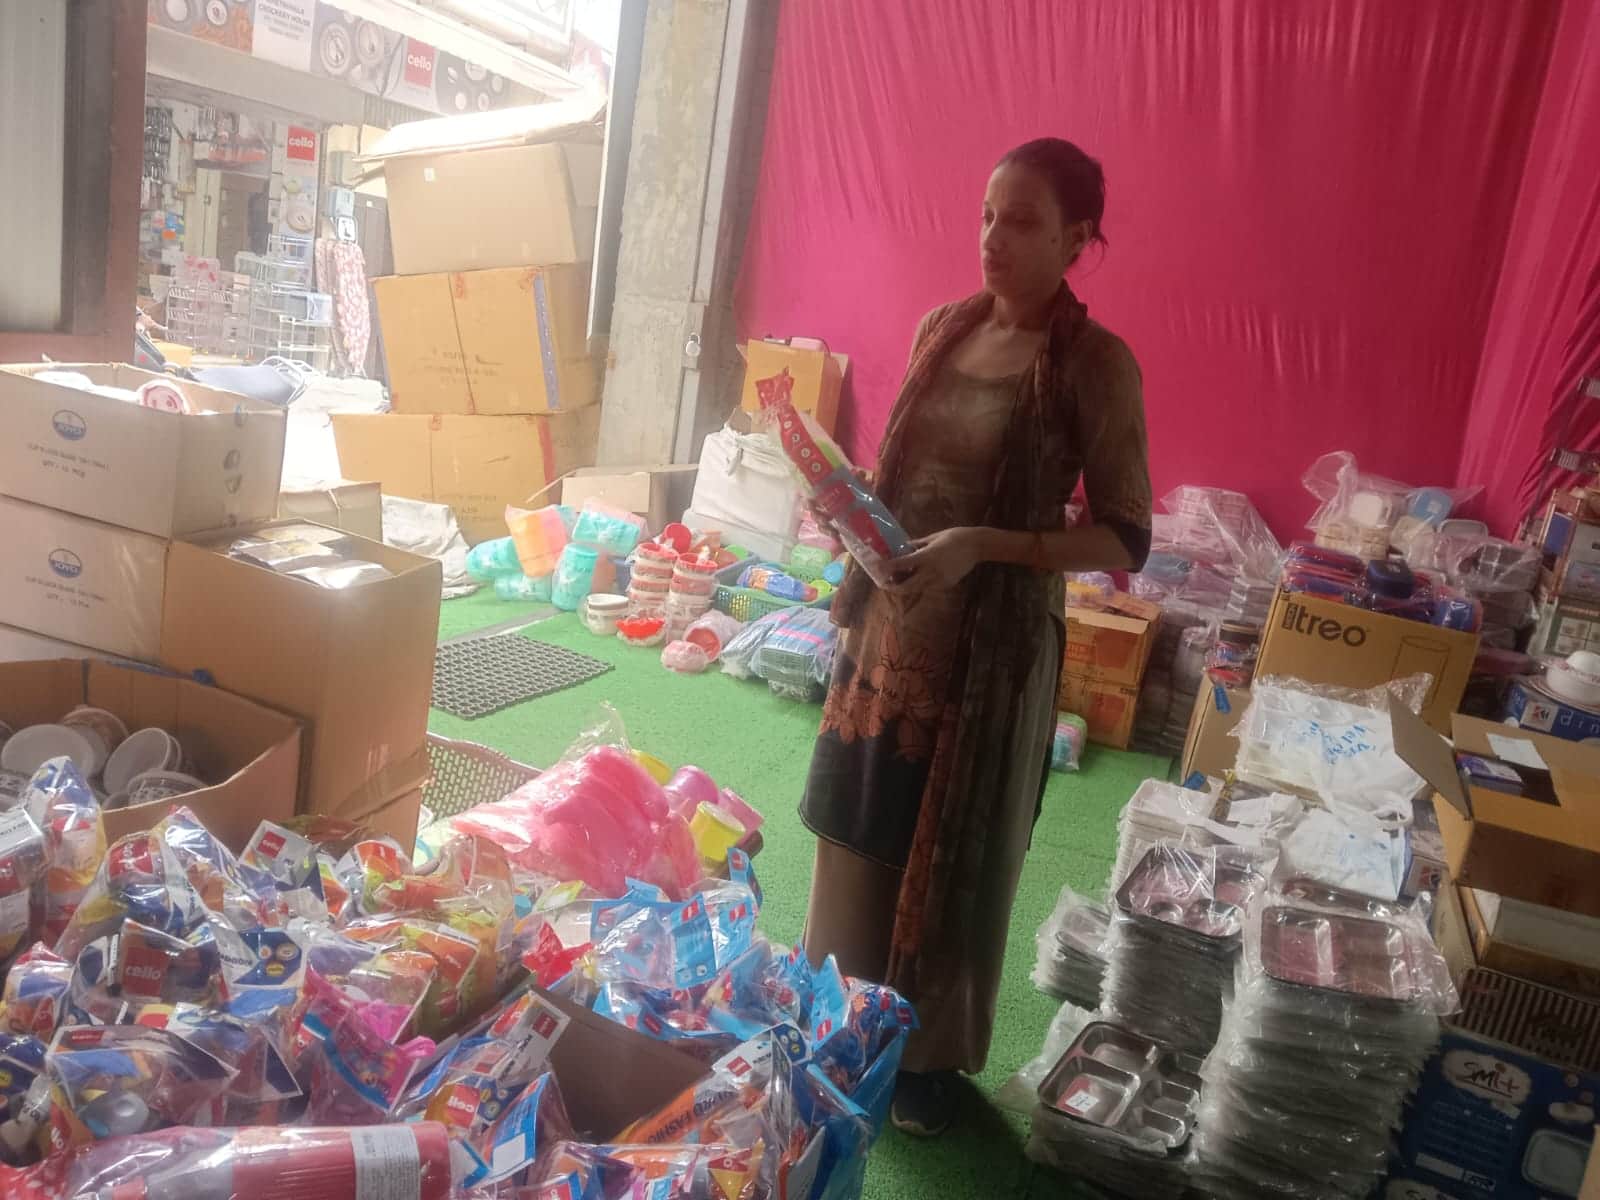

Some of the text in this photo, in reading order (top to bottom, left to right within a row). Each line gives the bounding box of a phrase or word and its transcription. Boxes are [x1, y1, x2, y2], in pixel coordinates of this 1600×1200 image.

[407, 54, 432, 71] cello
[288, 136, 314, 149] cello
[1295, 605, 1367, 647] treo
[125, 965, 161, 981] cello
[447, 1094, 476, 1113] cell
